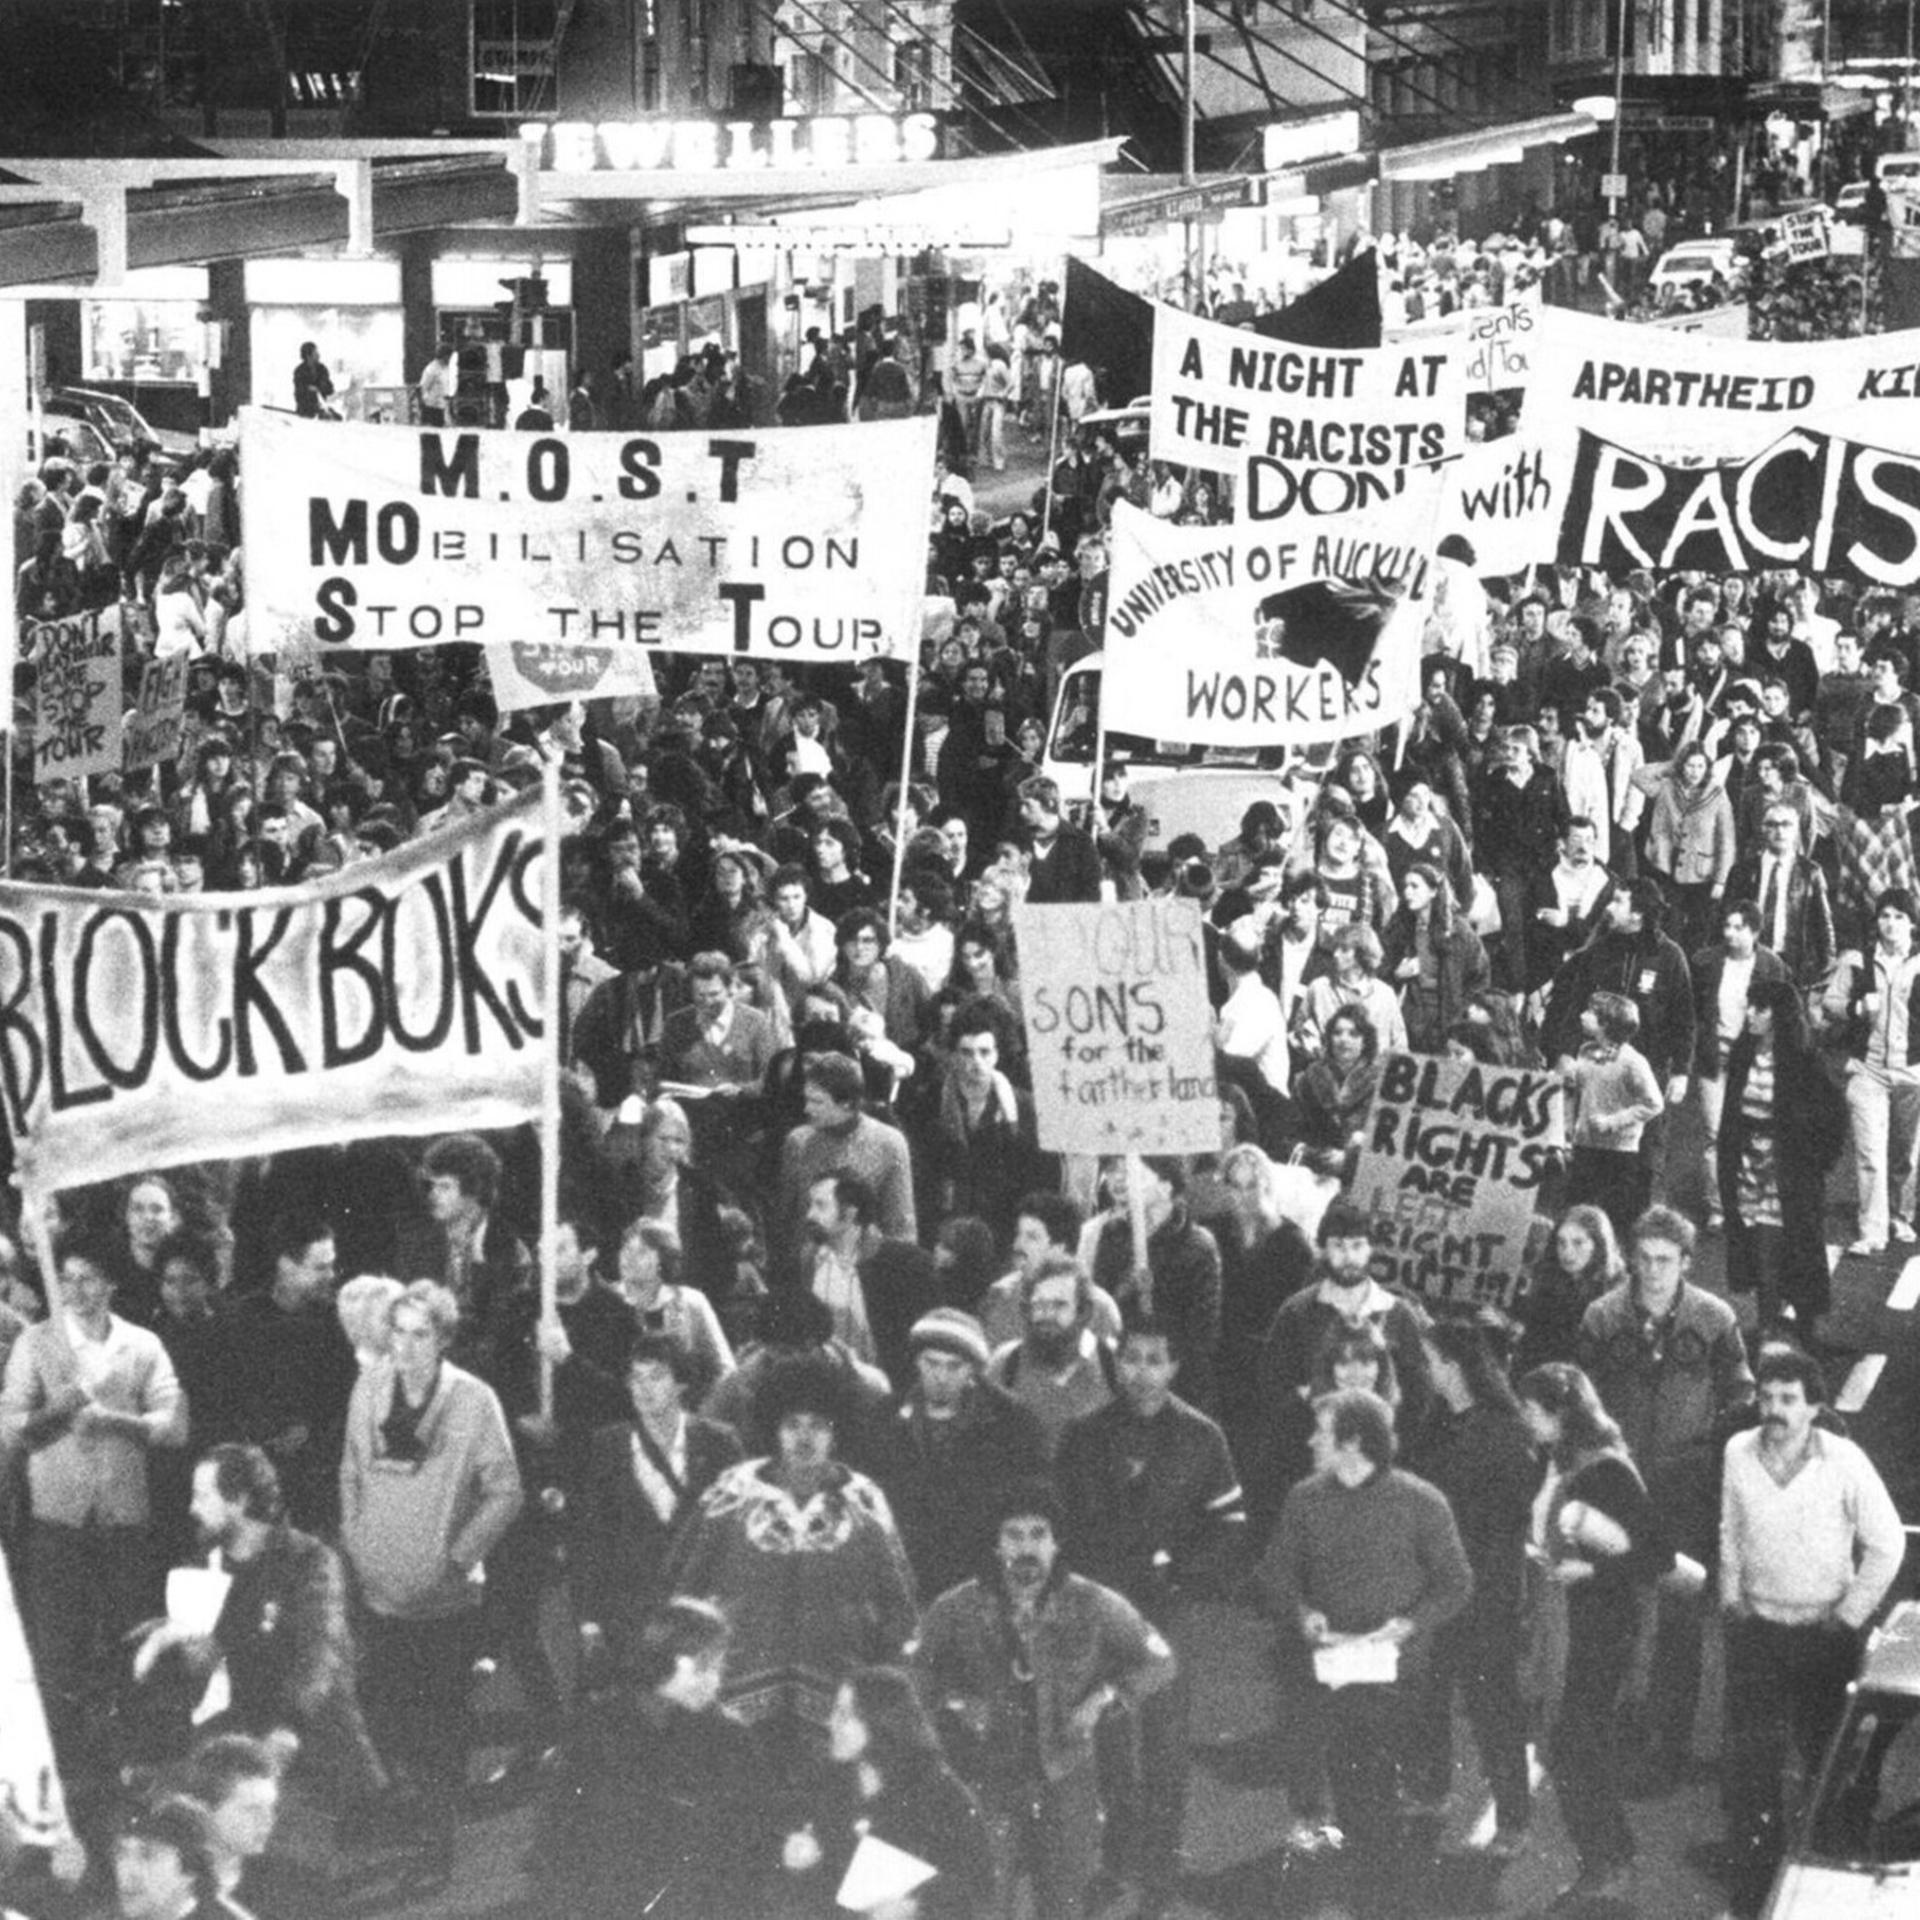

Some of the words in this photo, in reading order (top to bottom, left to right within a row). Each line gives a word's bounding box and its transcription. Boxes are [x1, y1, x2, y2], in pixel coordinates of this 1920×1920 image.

[1179, 338, 1203, 380] A
[1229, 347, 1363, 398] NIGHT
[1395, 355, 1448, 397] AT
[1572, 360, 1815, 412] APARTHEID
[1857, 363, 1920, 400] KI
[1172, 396, 1250, 448] THE
[1266, 416, 1445, 466] RACISTS
[1461, 448, 1552, 522] with
[308, 498, 859, 569] MOBILISATION
[314, 577, 485, 644] STOP
[547, 608, 663, 644] THE
[719, 583, 882, 653] TOUR
[1109, 545, 1234, 638] UNIVERSITY
[1246, 543, 1297, 582] OF
[1187, 659, 1382, 723] WORKERS
[37, 725, 105, 766] TOUR
[1033, 981, 1165, 1036] SONS
[1061, 1035, 1107, 1063] for
[1123, 1036, 1164, 1064] the
[1379, 1054, 1561, 1138] BLACKS
[1373, 1106, 1544, 1189] RIGHTS
[1399, 1165, 1478, 1208] ARE
[1374, 1220, 1506, 1269] RIGHT
